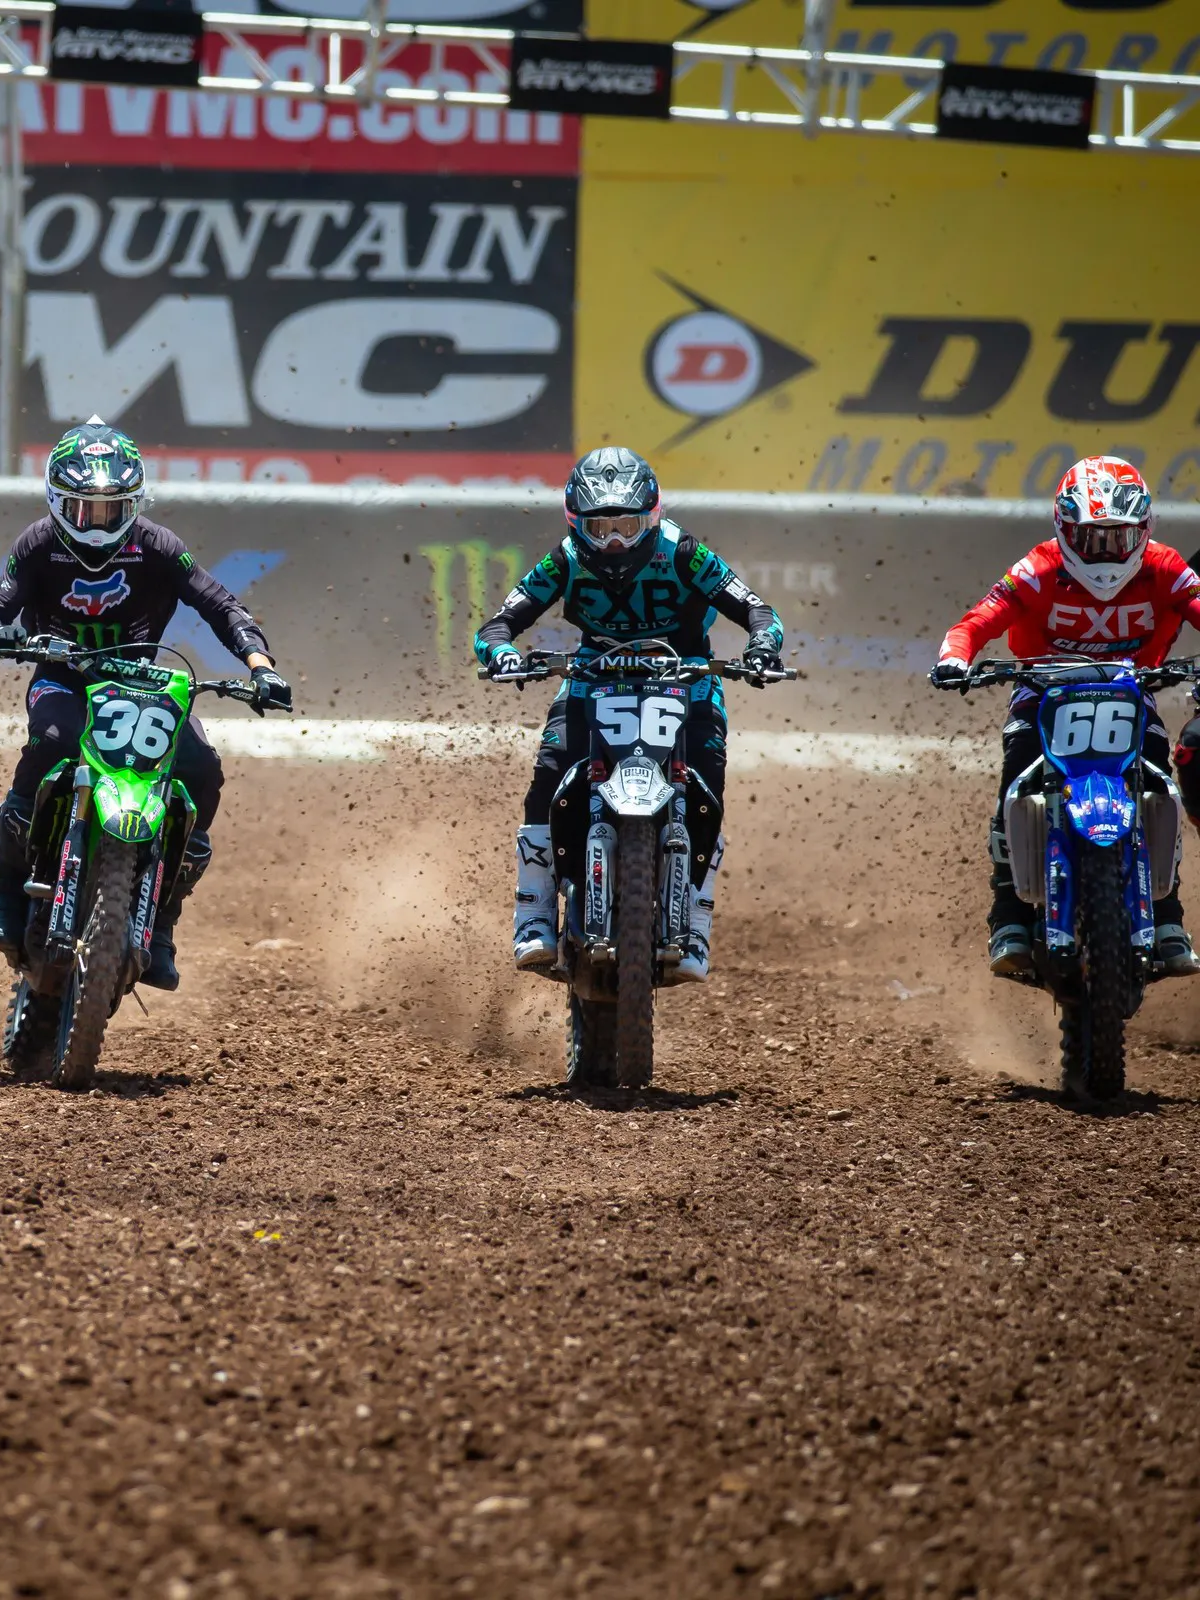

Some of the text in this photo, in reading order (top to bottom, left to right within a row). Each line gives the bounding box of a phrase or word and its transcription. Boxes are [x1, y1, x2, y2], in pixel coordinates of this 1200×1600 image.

[1047, 601, 1155, 640] FXR
[126, 690, 160, 702] MONSTER
[1075, 690, 1112, 698] MONSTER
[91, 699, 177, 759] 36
[595, 695, 685, 748] 56
[1050, 701, 1136, 757] 66
[133, 872, 151, 947] DUNLOP
[669, 856, 683, 931] DUNLOP
